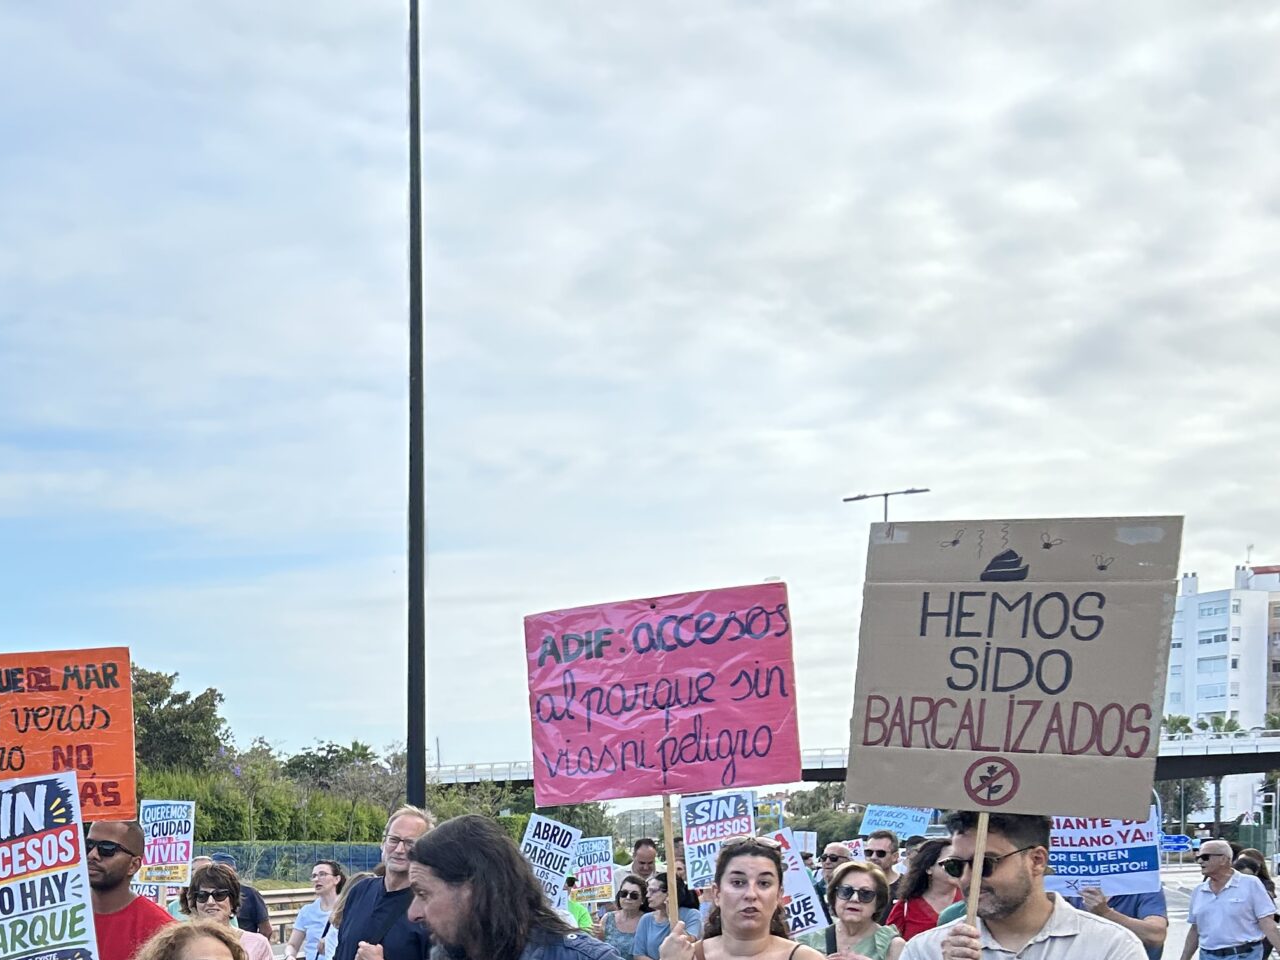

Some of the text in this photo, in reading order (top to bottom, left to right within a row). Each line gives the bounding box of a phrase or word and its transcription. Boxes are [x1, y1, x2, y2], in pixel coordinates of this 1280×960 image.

[920, 591, 1106, 642] HEMOS
[537, 603, 789, 667] ADIF: accesos
[61, 663, 120, 690] MAR
[536, 660, 790, 733] al parque sin
[10, 695, 111, 734] verás
[862, 694, 1152, 759] BARCALIZADOS
[52, 744, 95, 772] NO
[620, 731, 655, 772] ni
[144, 805, 188, 823] QUEREMOS
[695, 796, 737, 825] SIN
[151, 820, 192, 838] CIUDAD
[532, 821, 573, 849] ABRID
[688, 817, 750, 844] ACCESOS
[1117, 828, 1154, 844] YA!!
[144, 842, 187, 865] VIVIR
[523, 843, 570, 875] PARQUE
[577, 850, 611, 868] CIUDAD
[697, 842, 717, 859] NO
[1049, 849, 1129, 862] OR EL TREN
[536, 868, 550, 881] LOS
[19, 872, 69, 911] HAY
